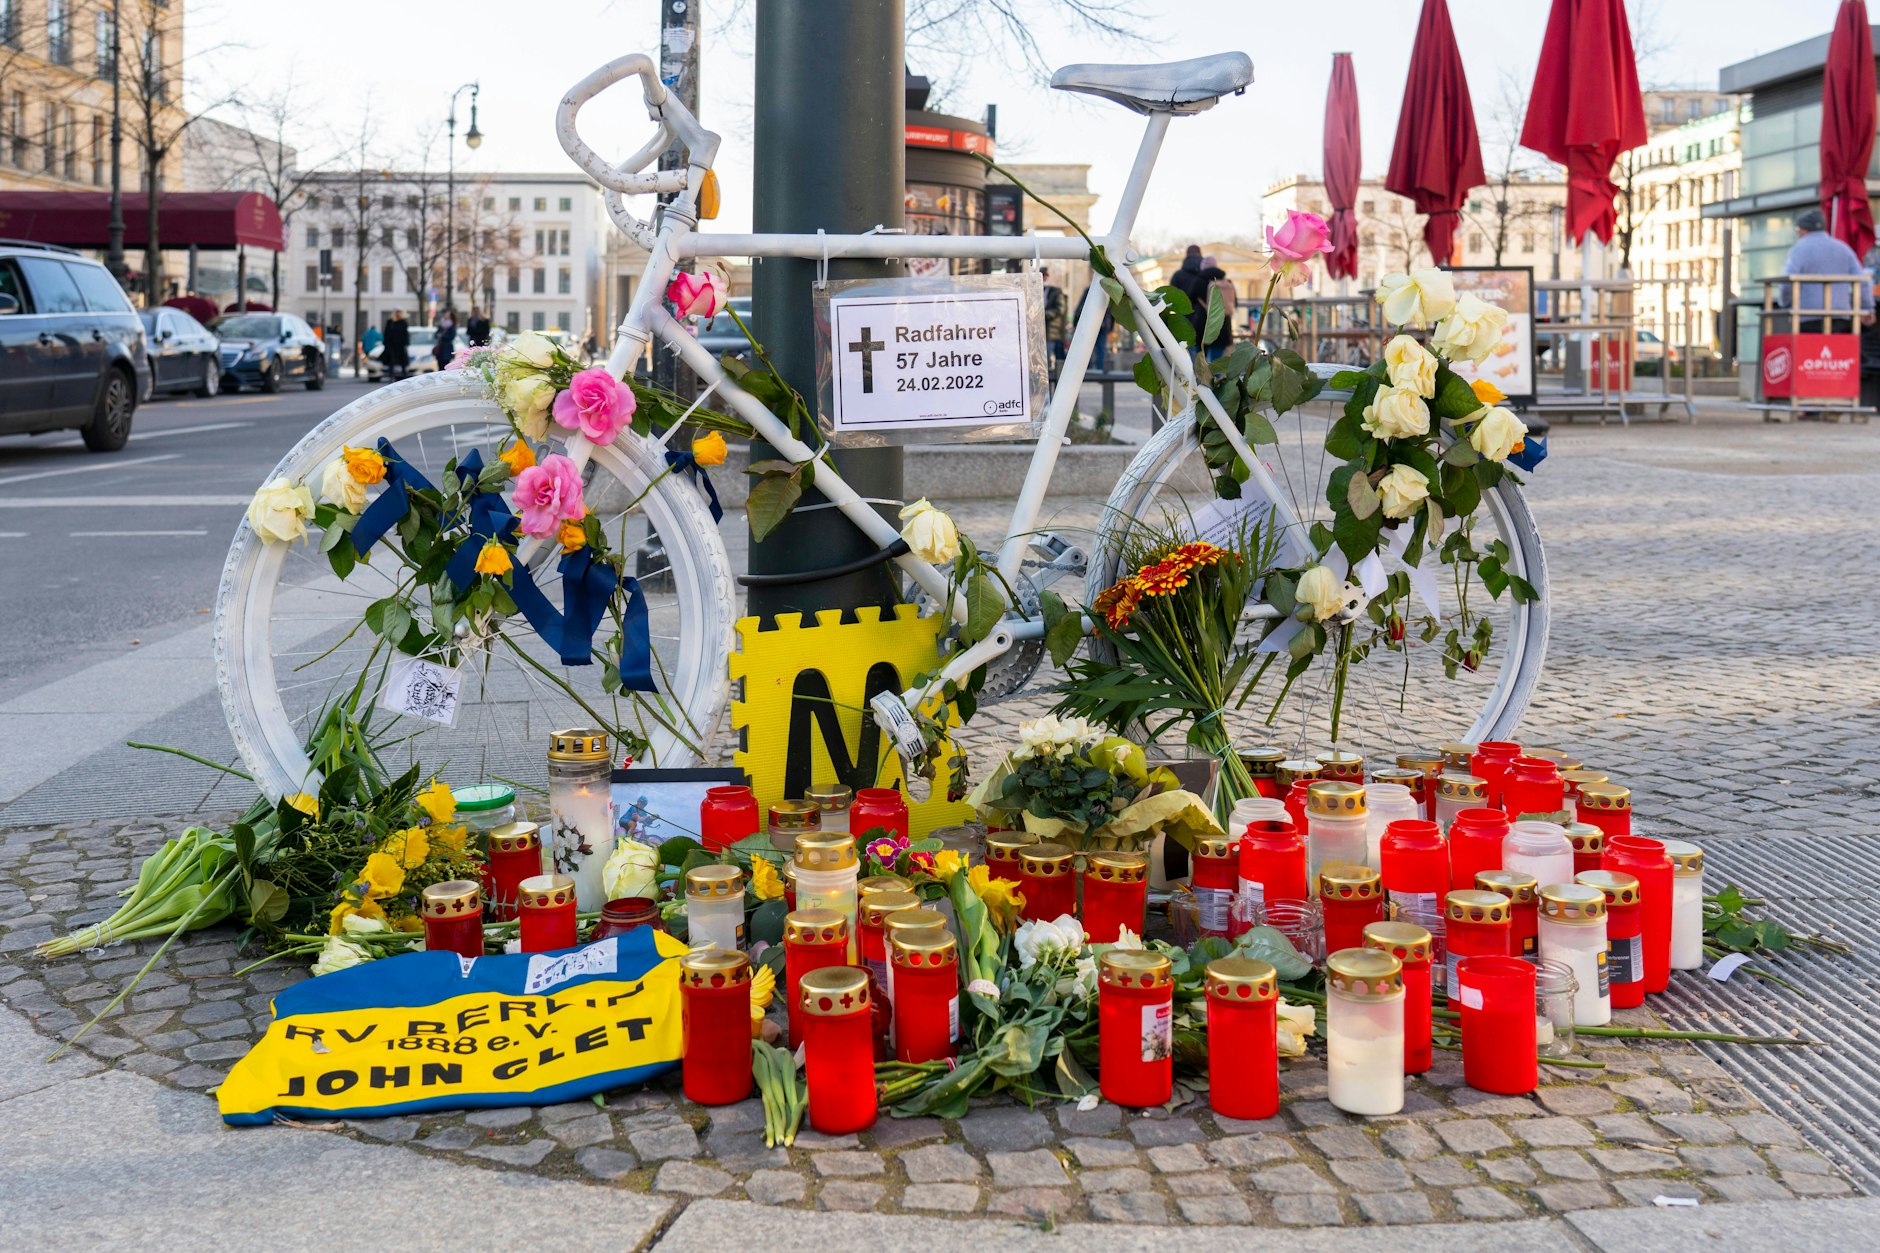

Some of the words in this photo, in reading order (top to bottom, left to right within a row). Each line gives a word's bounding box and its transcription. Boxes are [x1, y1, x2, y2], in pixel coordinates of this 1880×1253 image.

[895, 324, 996, 343] Radfahrer
[896, 352, 919, 370] 57
[926, 350, 983, 369] Jahre
[897, 375, 984, 392] 24.02.2022
[998, 400, 1021, 409] adfc
[285, 1024, 378, 1044] RV
[381, 1036, 478, 1055] 1888
[277, 1062, 463, 1097] JOHN
[492, 1017, 653, 1080] GLET
